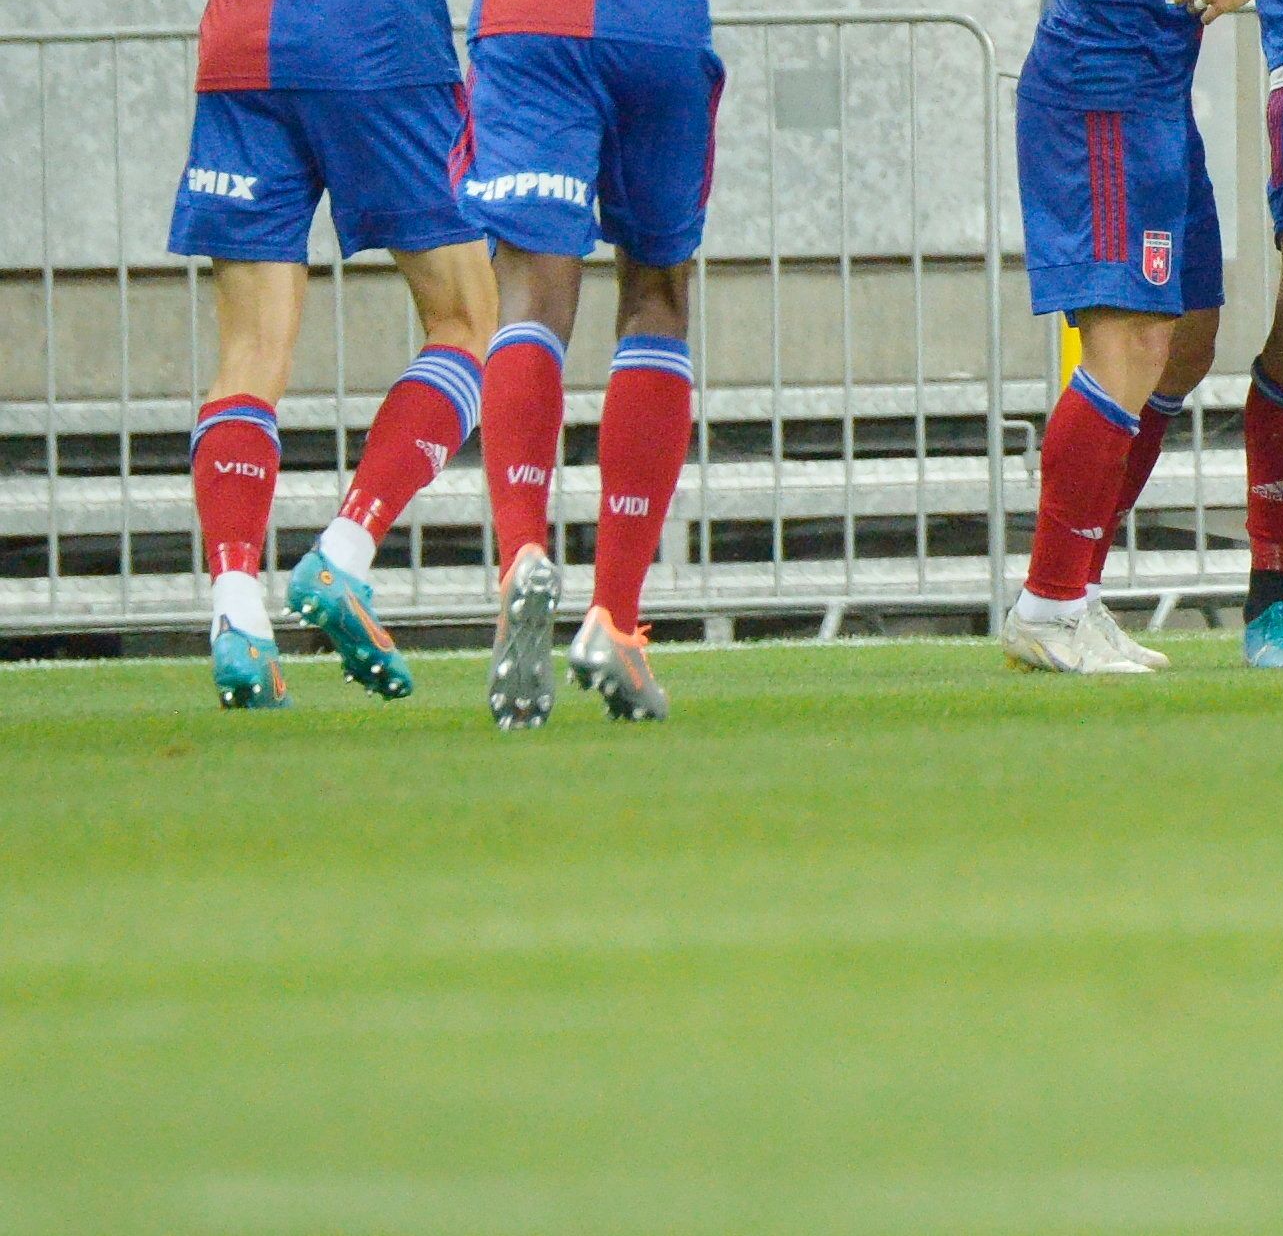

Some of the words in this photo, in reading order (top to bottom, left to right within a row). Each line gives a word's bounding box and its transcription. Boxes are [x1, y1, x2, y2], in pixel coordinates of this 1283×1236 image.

[213, 460, 266, 480] VIDI
[507, 465, 546, 485] VIDI
[609, 495, 649, 517] VIDI
